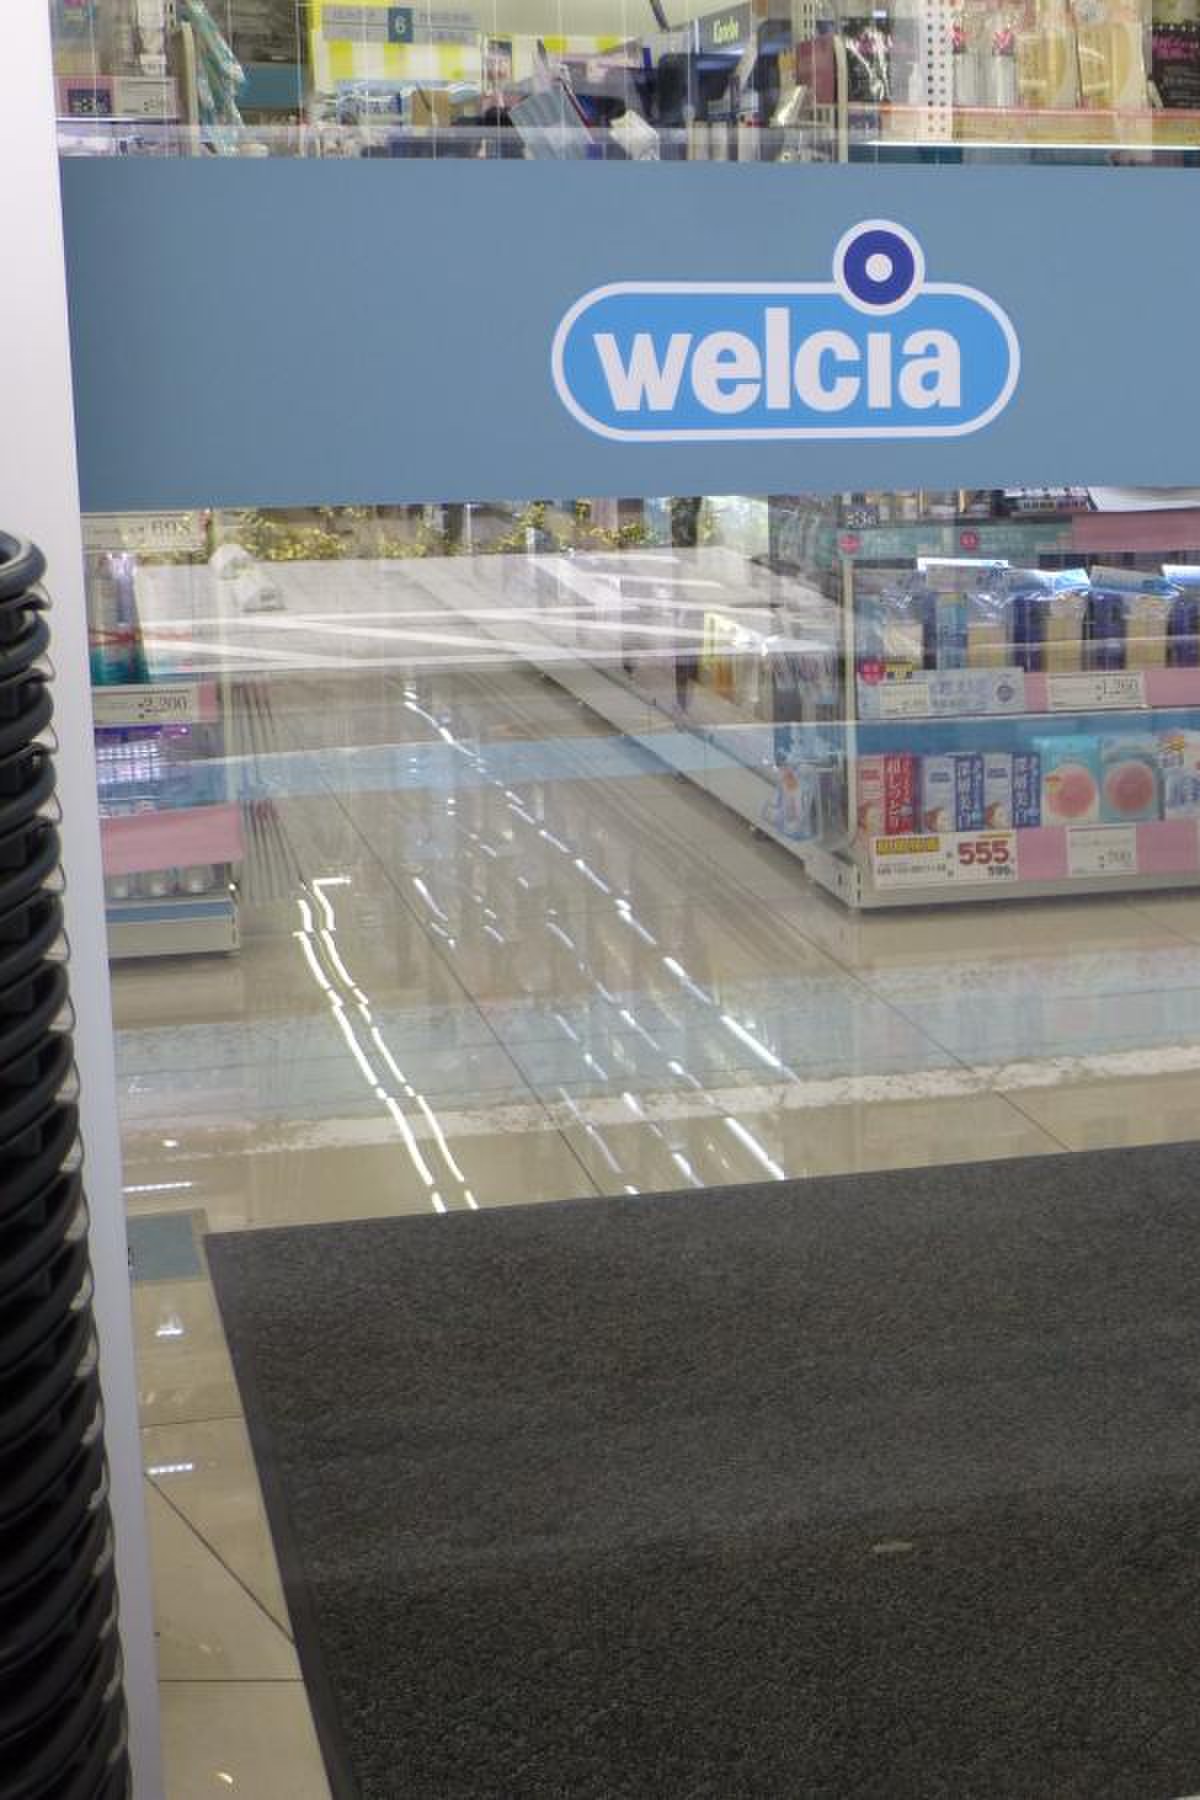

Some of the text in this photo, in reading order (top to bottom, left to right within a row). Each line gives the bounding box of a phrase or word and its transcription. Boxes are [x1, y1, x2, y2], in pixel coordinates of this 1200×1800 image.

[394, 16, 406, 34] 6
[593, 306, 961, 415] welcia
[959, 841, 1009, 865] 555
